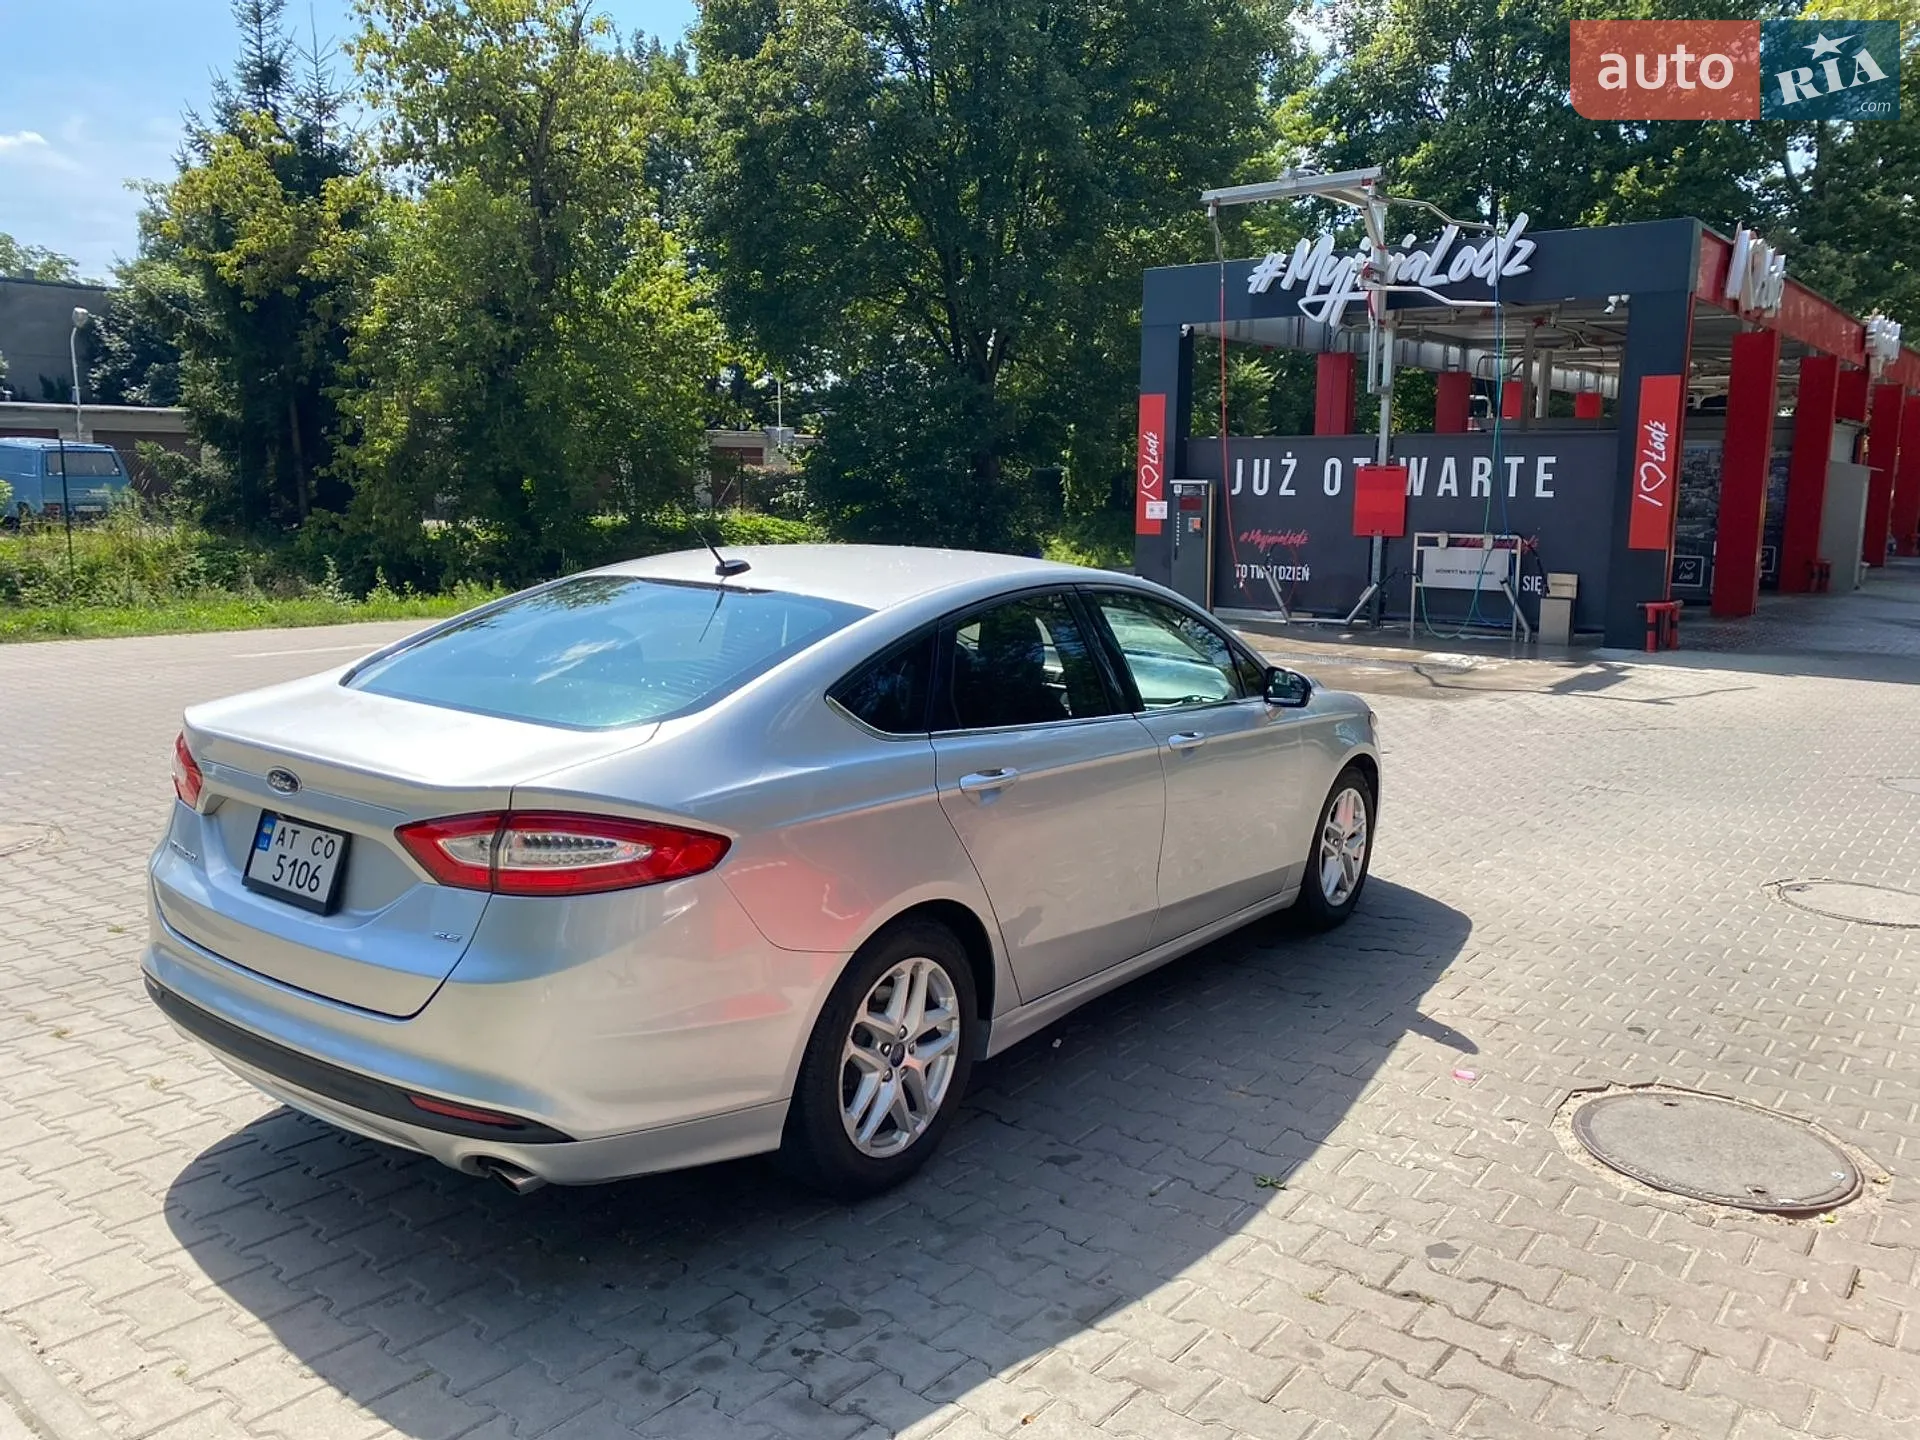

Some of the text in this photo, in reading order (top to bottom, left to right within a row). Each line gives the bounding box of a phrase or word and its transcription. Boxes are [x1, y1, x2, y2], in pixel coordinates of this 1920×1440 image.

[1231, 452, 1298, 496] JUŻ
[1234, 563, 1248, 579] TO
[1278, 563, 1310, 582] DZIEŃ
[1522, 576, 1543, 595] SIĘ
[275, 826, 336, 860] AT CO
[271, 853, 323, 893] 5106
